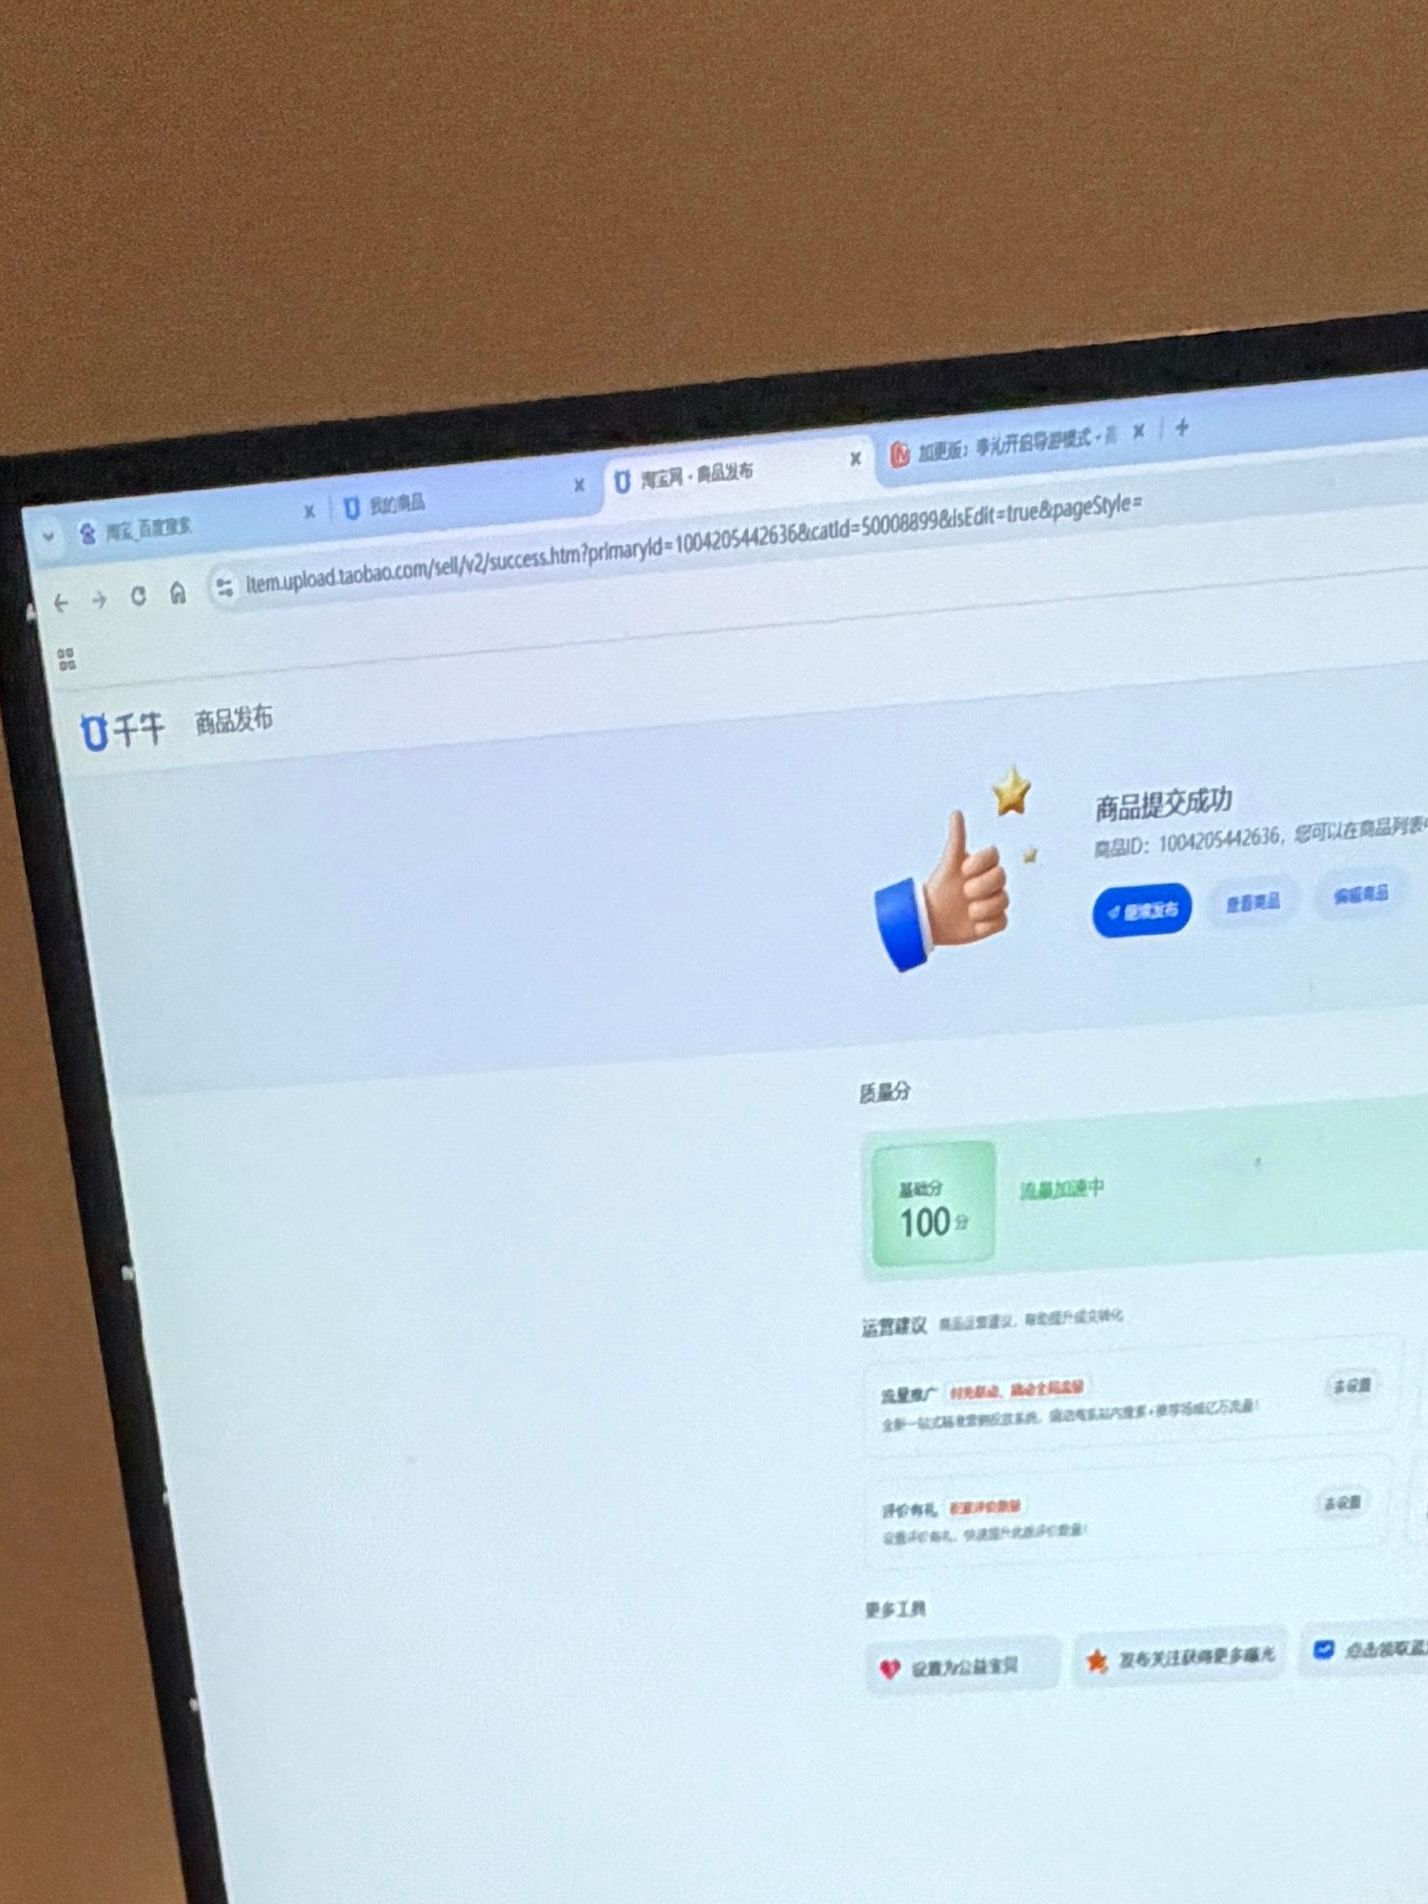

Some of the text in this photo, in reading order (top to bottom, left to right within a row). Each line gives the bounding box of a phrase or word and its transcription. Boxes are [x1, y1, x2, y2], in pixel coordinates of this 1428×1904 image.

[113, 702, 273, 748] 千牛 商品发布
[1096, 786, 1233, 823] 商品提交成功
[859, 1080, 911, 1104] 质量分
[900, 1206, 950, 1237] 100
[865, 1600, 926, 1619] 更多工具
